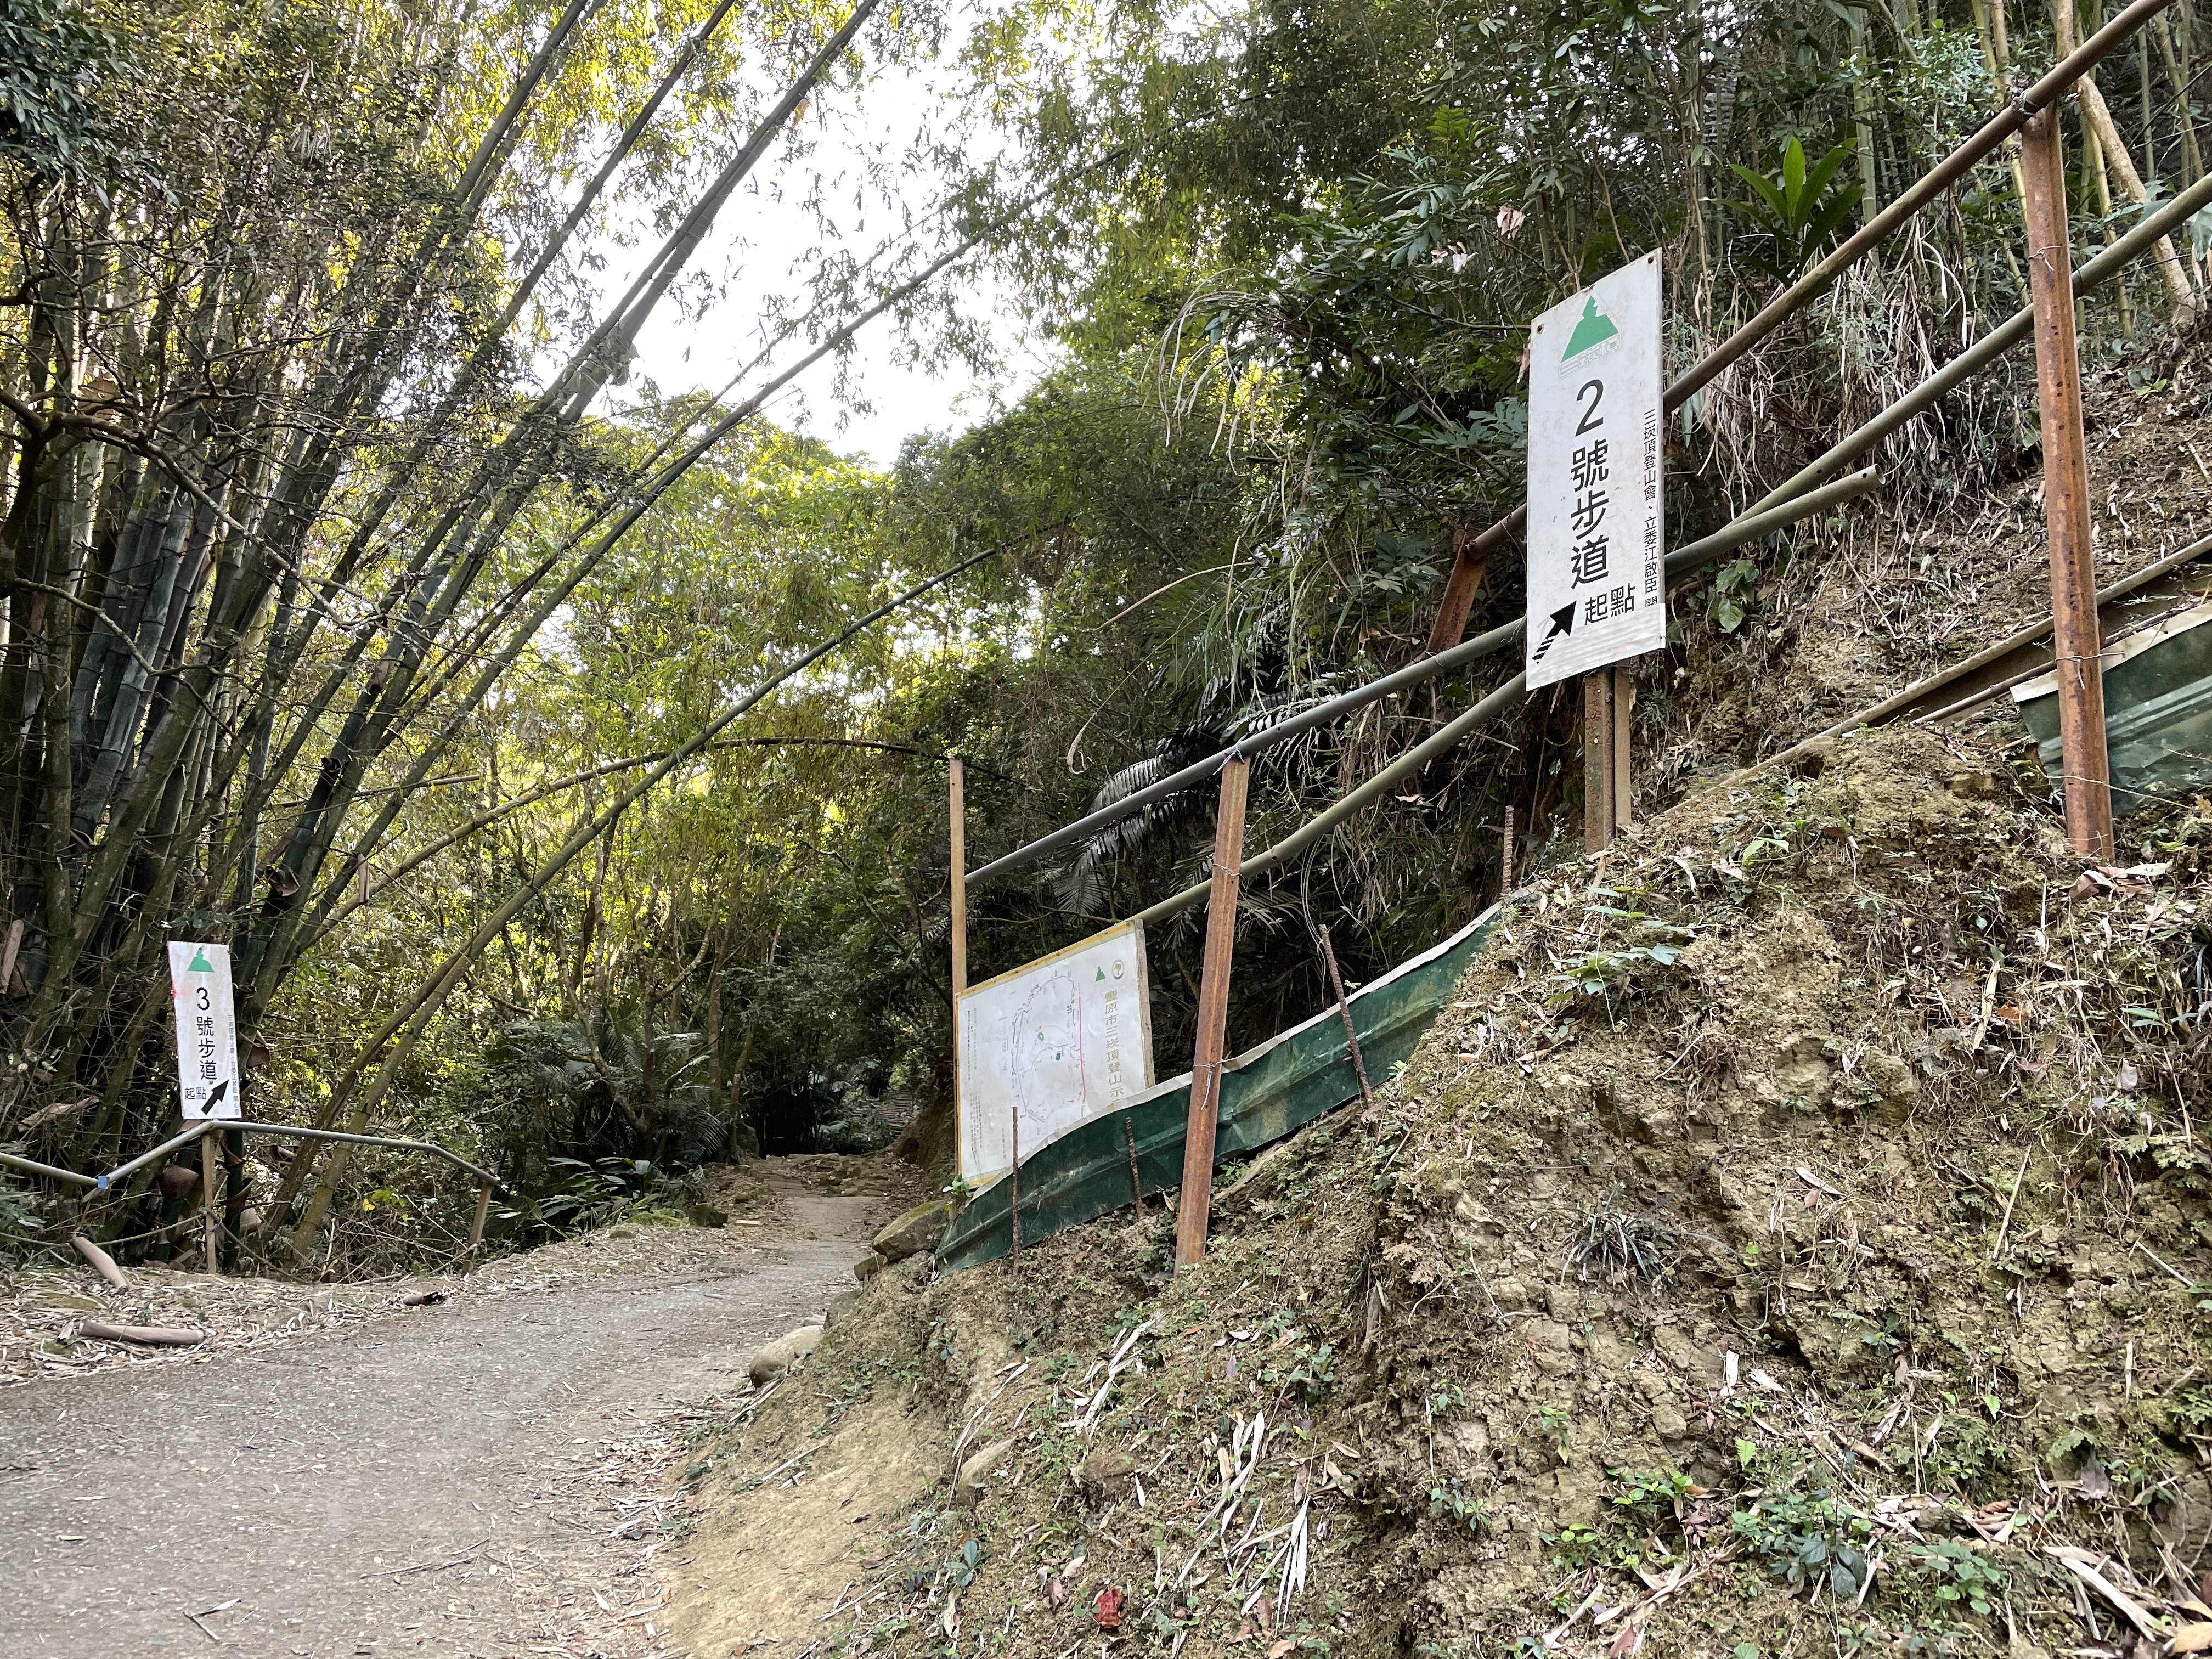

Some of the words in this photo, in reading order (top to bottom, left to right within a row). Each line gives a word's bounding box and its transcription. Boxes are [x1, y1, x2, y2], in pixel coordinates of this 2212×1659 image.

[1571, 379, 1609, 590] 2號步道
[1584, 583, 1635, 625] 起點
[196, 988, 217, 1080] 3號步道
[1104, 990, 1124, 1102] 豐原市三崁頂登山示
[184, 1087, 207, 1100] 起點
